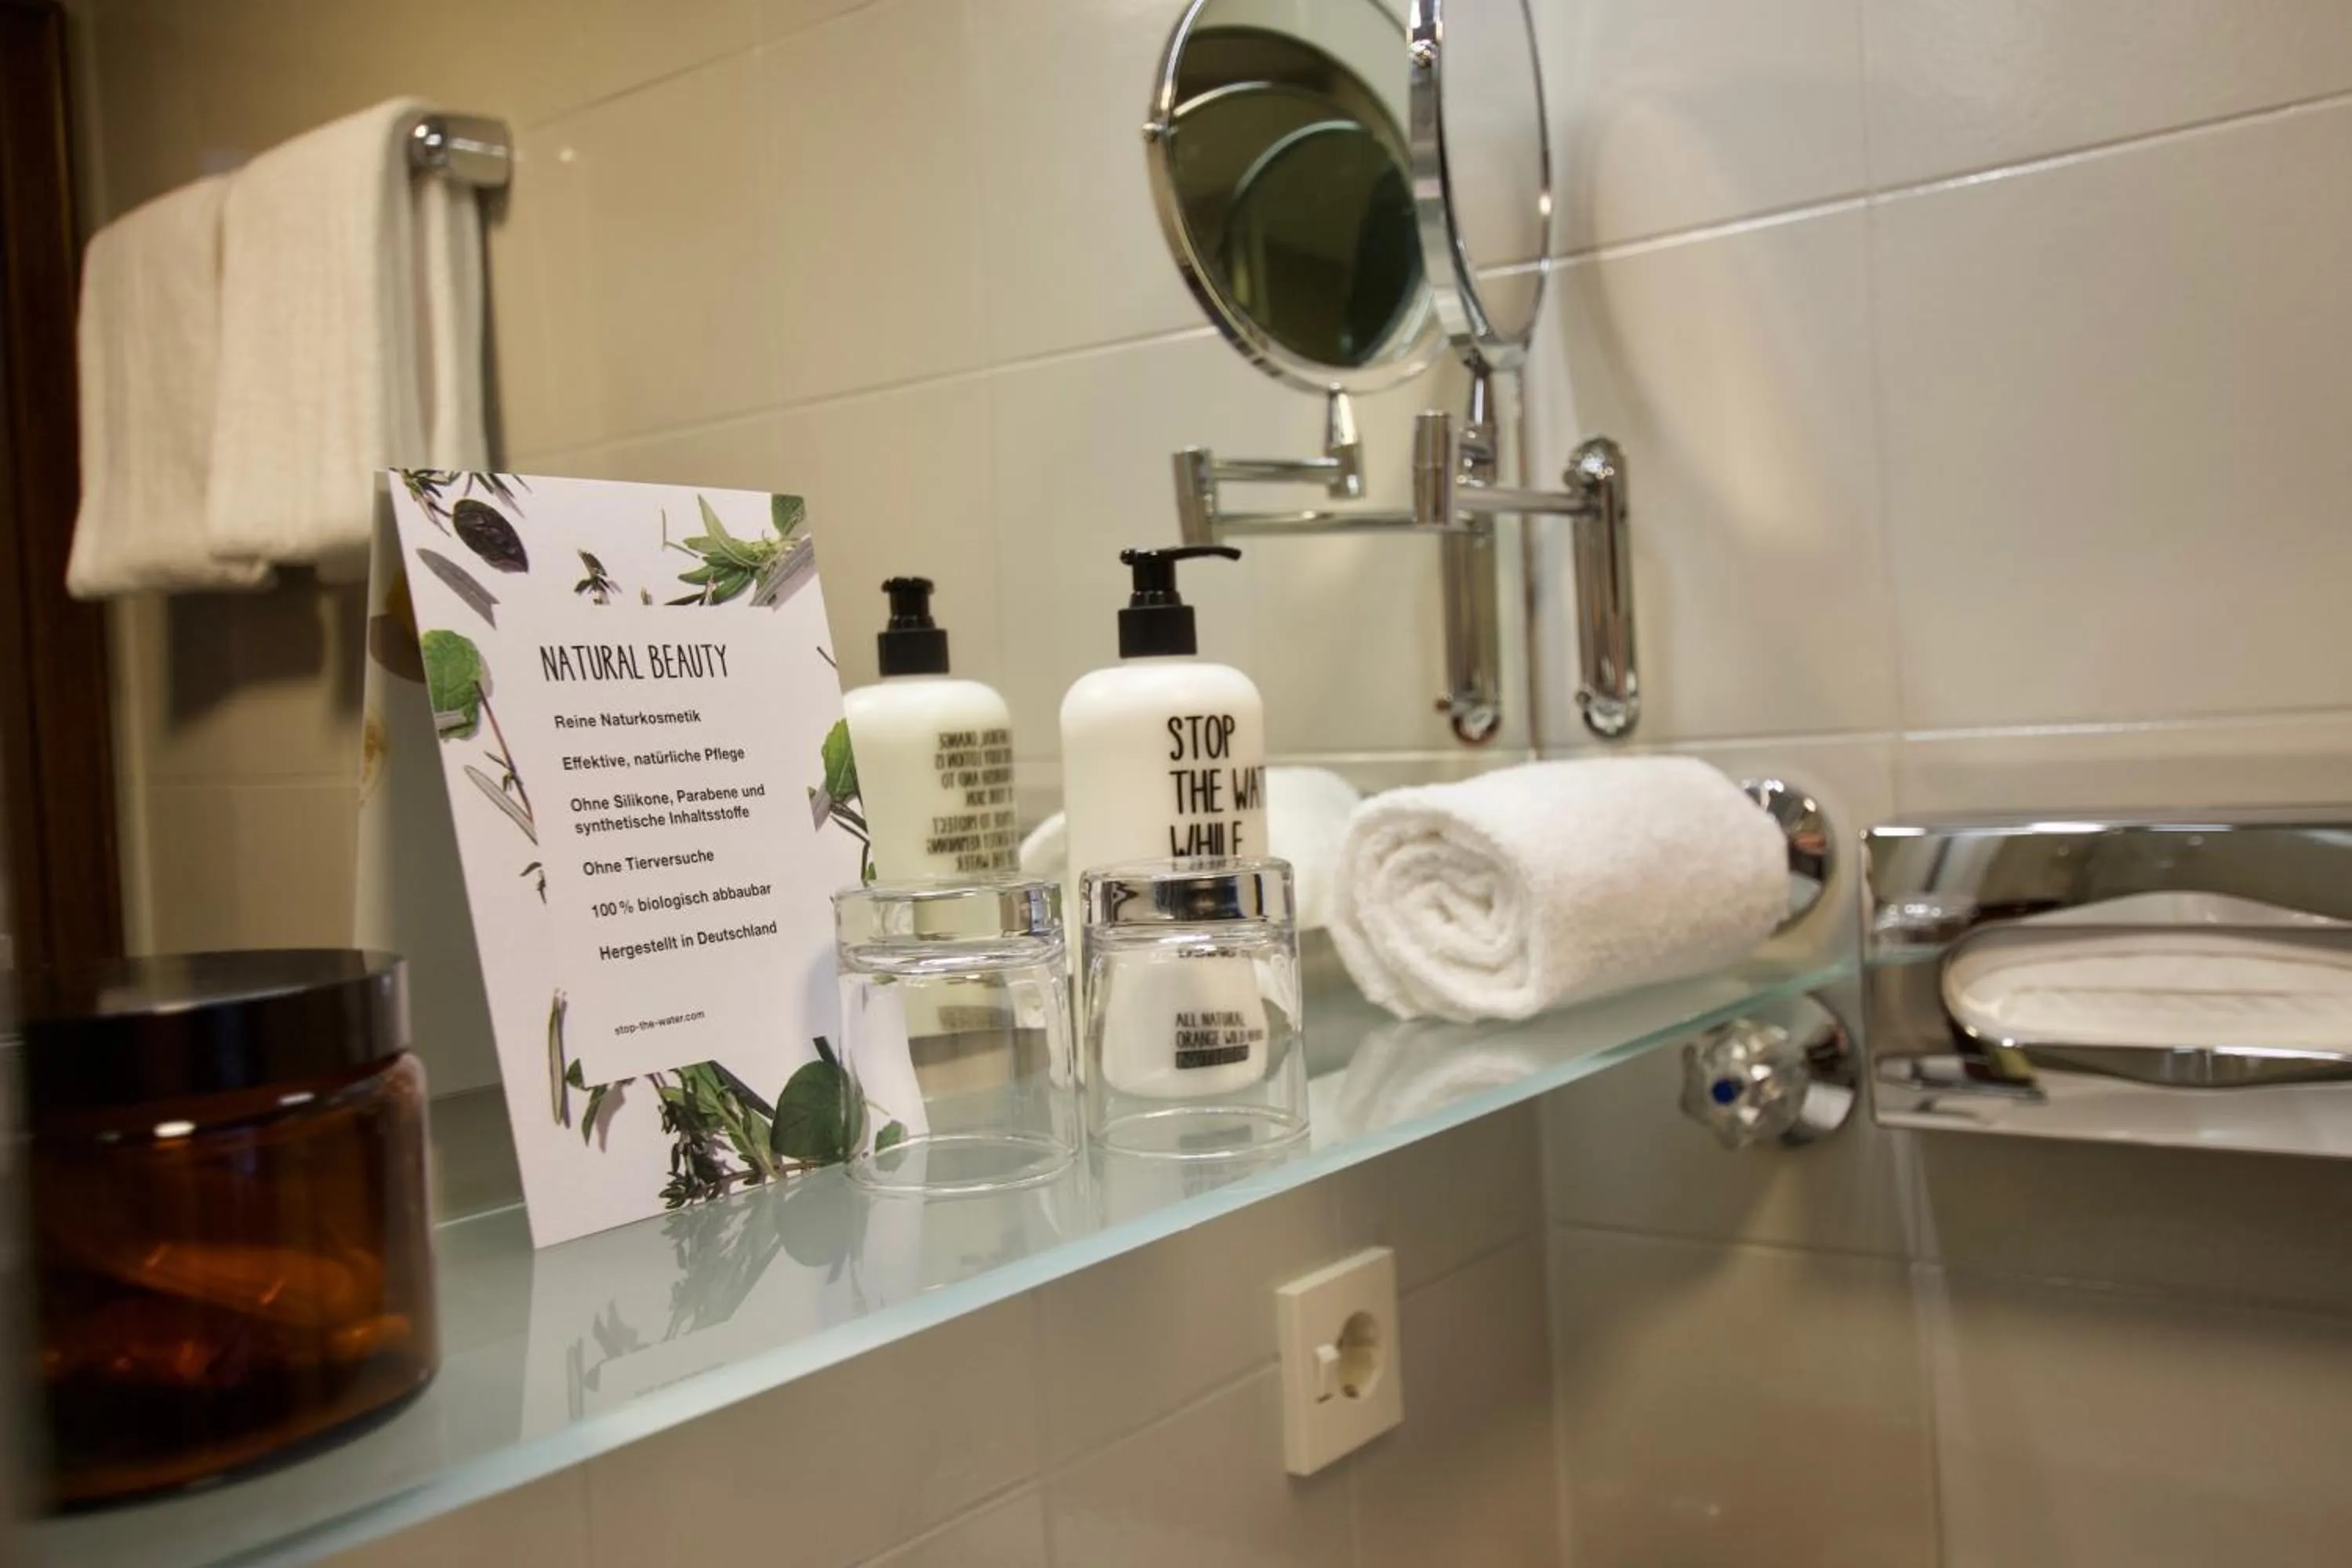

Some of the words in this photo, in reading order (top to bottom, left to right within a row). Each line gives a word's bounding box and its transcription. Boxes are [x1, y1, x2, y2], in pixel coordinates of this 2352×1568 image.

[539, 644, 644, 681] NATURAL
[648, 644, 728, 678] BEAUTY
[554, 714, 596, 728] Reine
[600, 710, 702, 726] Naturkosmetik
[1167, 714, 1236, 761] STOP
[562, 755, 630, 771] Effektive,
[633, 750, 701, 766] natürliche
[705, 747, 745, 763] Pflege
[571, 798, 609, 811] Ohne
[614, 793, 673, 808] Silikone,
[677, 786, 739, 803] Parabene
[741, 784, 765, 797] und
[1168, 768, 1225, 815] THE
[575, 815, 666, 836] synthetische
[669, 806, 750, 824] Inhaltsstoffe
[583, 861, 622, 876] Ohne
[626, 849, 714, 871] Tierversuche
[637, 891, 708, 912] biologisch
[713, 883, 771, 901] abbaubar
[599, 938, 678, 960] Hergestellt
[681, 935, 694, 947] in
[697, 921, 778, 946] Deutschland
[614, 1011, 705, 1035] stop-the-water.com
[1175, 1012, 1196, 1027] ALL
